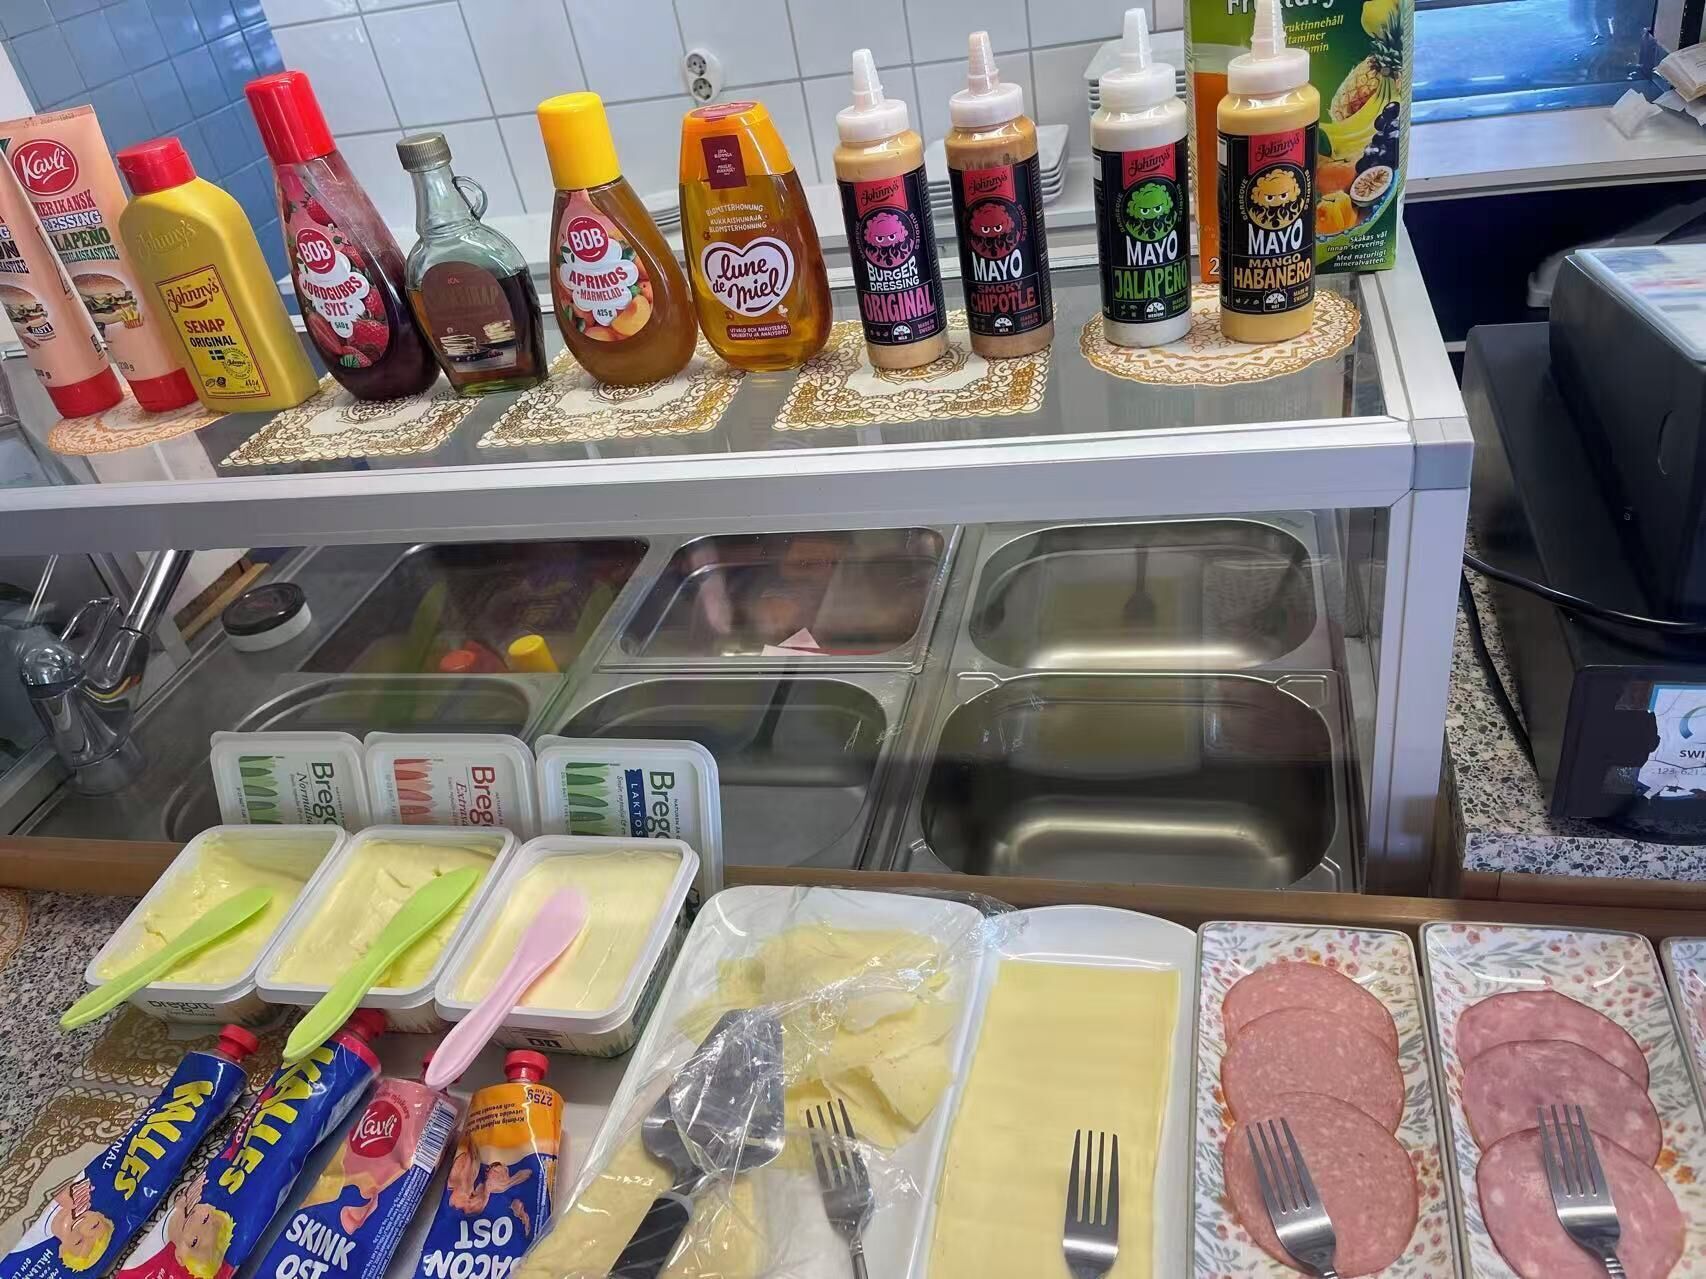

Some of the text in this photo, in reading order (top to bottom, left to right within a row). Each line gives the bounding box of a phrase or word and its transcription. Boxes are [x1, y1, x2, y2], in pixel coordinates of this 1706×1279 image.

[1285, 15, 1344, 33] ruktinnehåll
[1287, 32, 1326, 45] taminer
[1255, 133, 1301, 162] Johnny's
[20, 147, 70, 187] Kavli
[1128, 148, 1171, 177] Johnny's
[861, 179, 899, 207] Johnny's
[968, 170, 1008, 196] Johnny's
[41, 210, 102, 233] RESSING
[706, 203, 764, 217] BLOMSTERHONUNG
[710, 214, 763, 226] KUKKAISHUNAJA
[570, 227, 605, 252] BOB
[708, 221, 768, 234] BLOMSTERHONNING
[909, 212, 921, 250] BUDDIES
[1247, 218, 1304, 256] MAYO
[1351, 233, 1374, 243] Skakas
[299, 239, 332, 263] BOB
[1126, 229, 1178, 266] MAYO
[1248, 253, 1301, 268] MANGO
[1354, 249, 1387, 259] naturligt
[569, 266, 629, 290] APRIKOS
[866, 255, 918, 282] BURGER
[971, 248, 1023, 282] MAYO
[1233, 257, 1312, 290] HABANERO
[302, 275, 363, 301] JORDGUBBS
[712, 267, 781, 310] de miel
[870, 275, 920, 292] DRESSING
[977, 281, 1023, 294] SMOKY
[1114, 259, 1188, 300] JALAPEÑO
[167, 277, 220, 314] Johnny's
[580, 287, 623, 302] MARMELAD
[863, 284, 935, 322] ORIGINAL
[970, 286, 1037, 314] CHIPOTLE
[183, 317, 226, 335] SENAP
[189, 335, 237, 348] ORIGINAL
[114, 1080, 214, 1201] KALLES
[351, 1108, 398, 1147] Kavli
[285, 1212, 358, 1271] SKINK
[454, 1216, 514, 1250] OST
